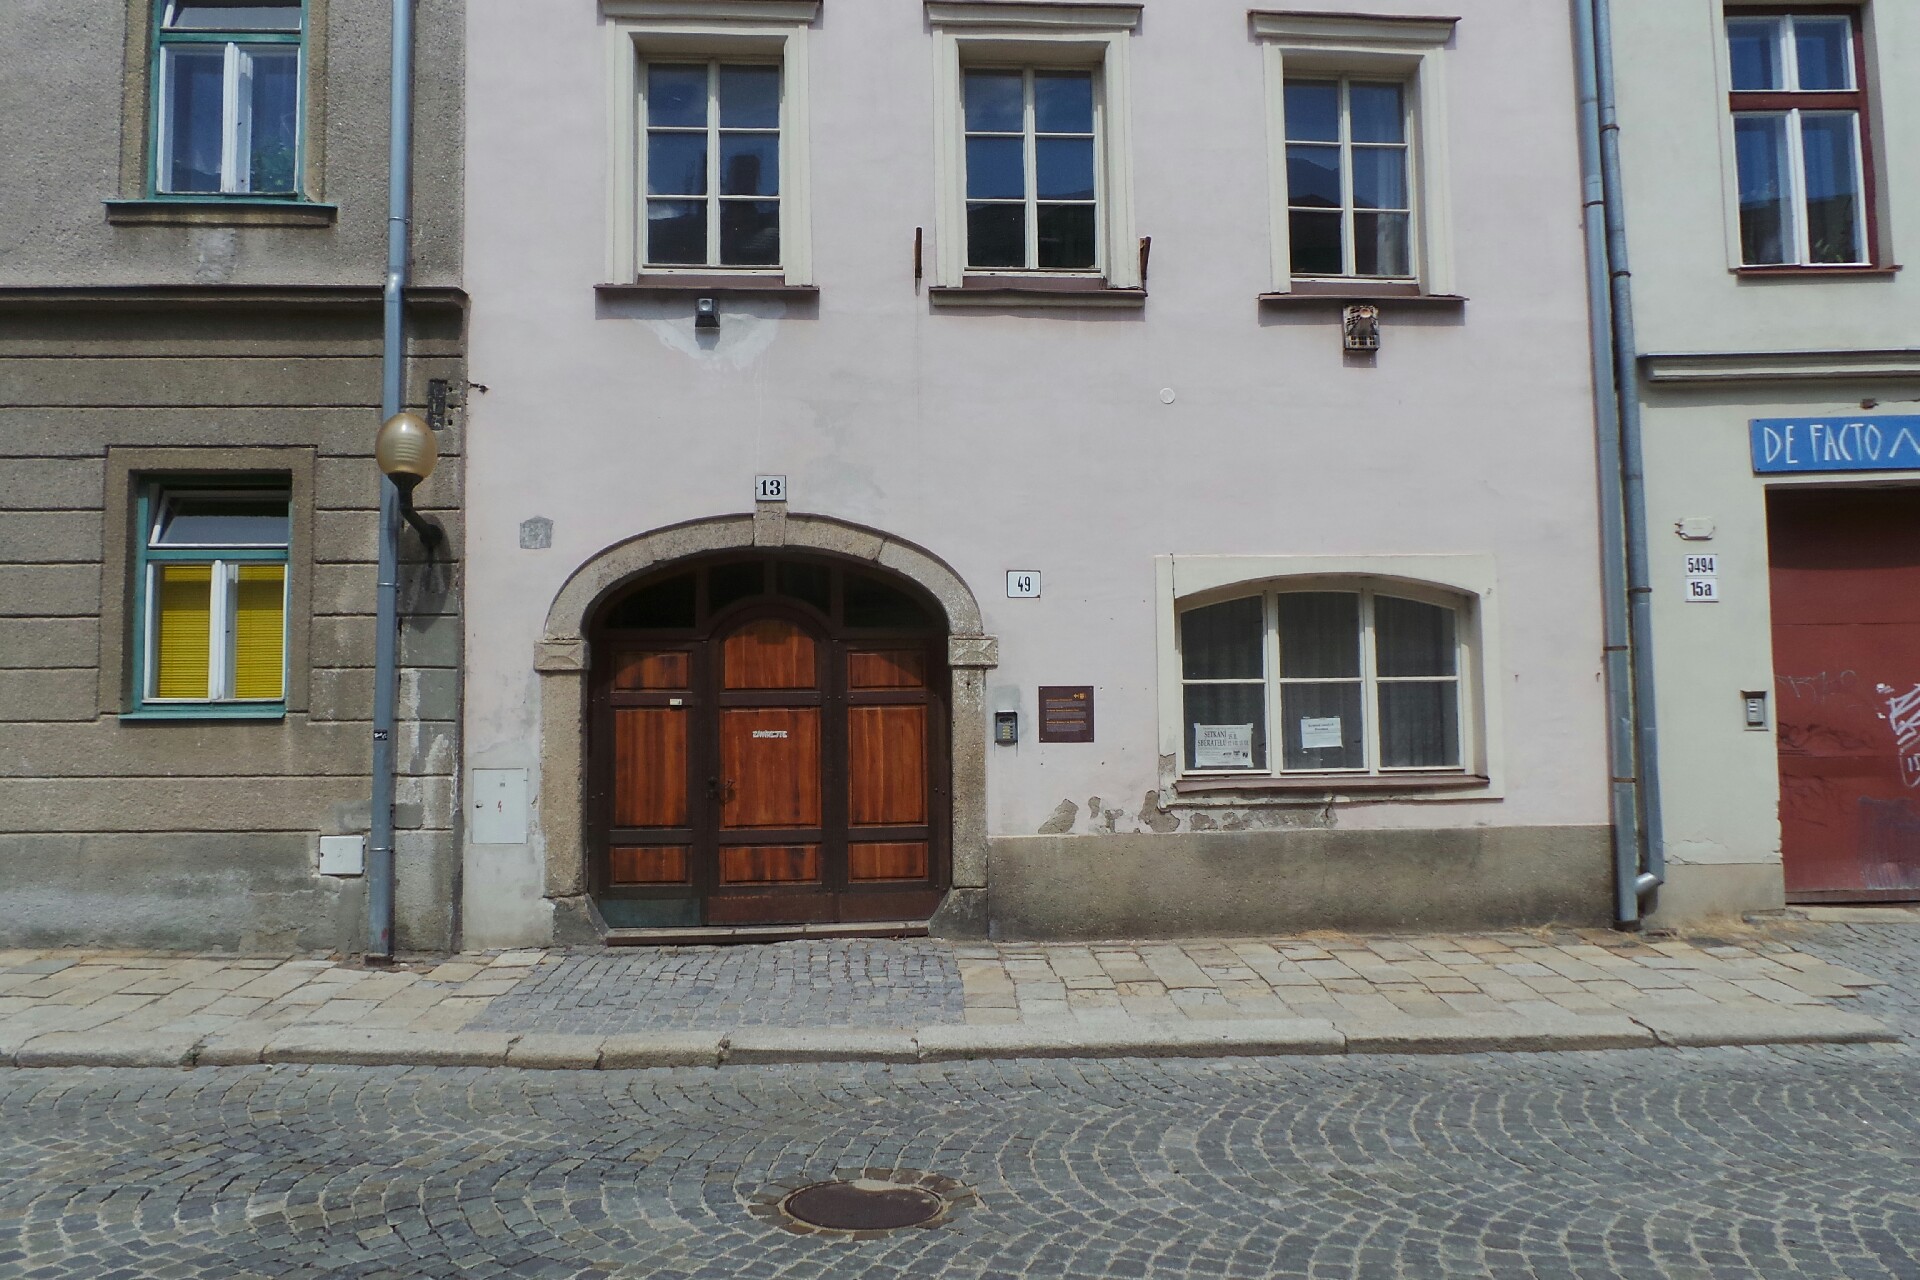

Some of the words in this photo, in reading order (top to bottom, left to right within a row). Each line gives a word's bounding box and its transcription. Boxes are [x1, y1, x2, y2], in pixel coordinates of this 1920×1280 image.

[1763, 424, 1798, 464] DE
[1809, 423, 1882, 462] FACTO
[760, 479, 782, 496] 13
[1687, 557, 1714, 574] 5494
[1017, 575, 1031, 592] 49
[1690, 581, 1712, 597] 15a
